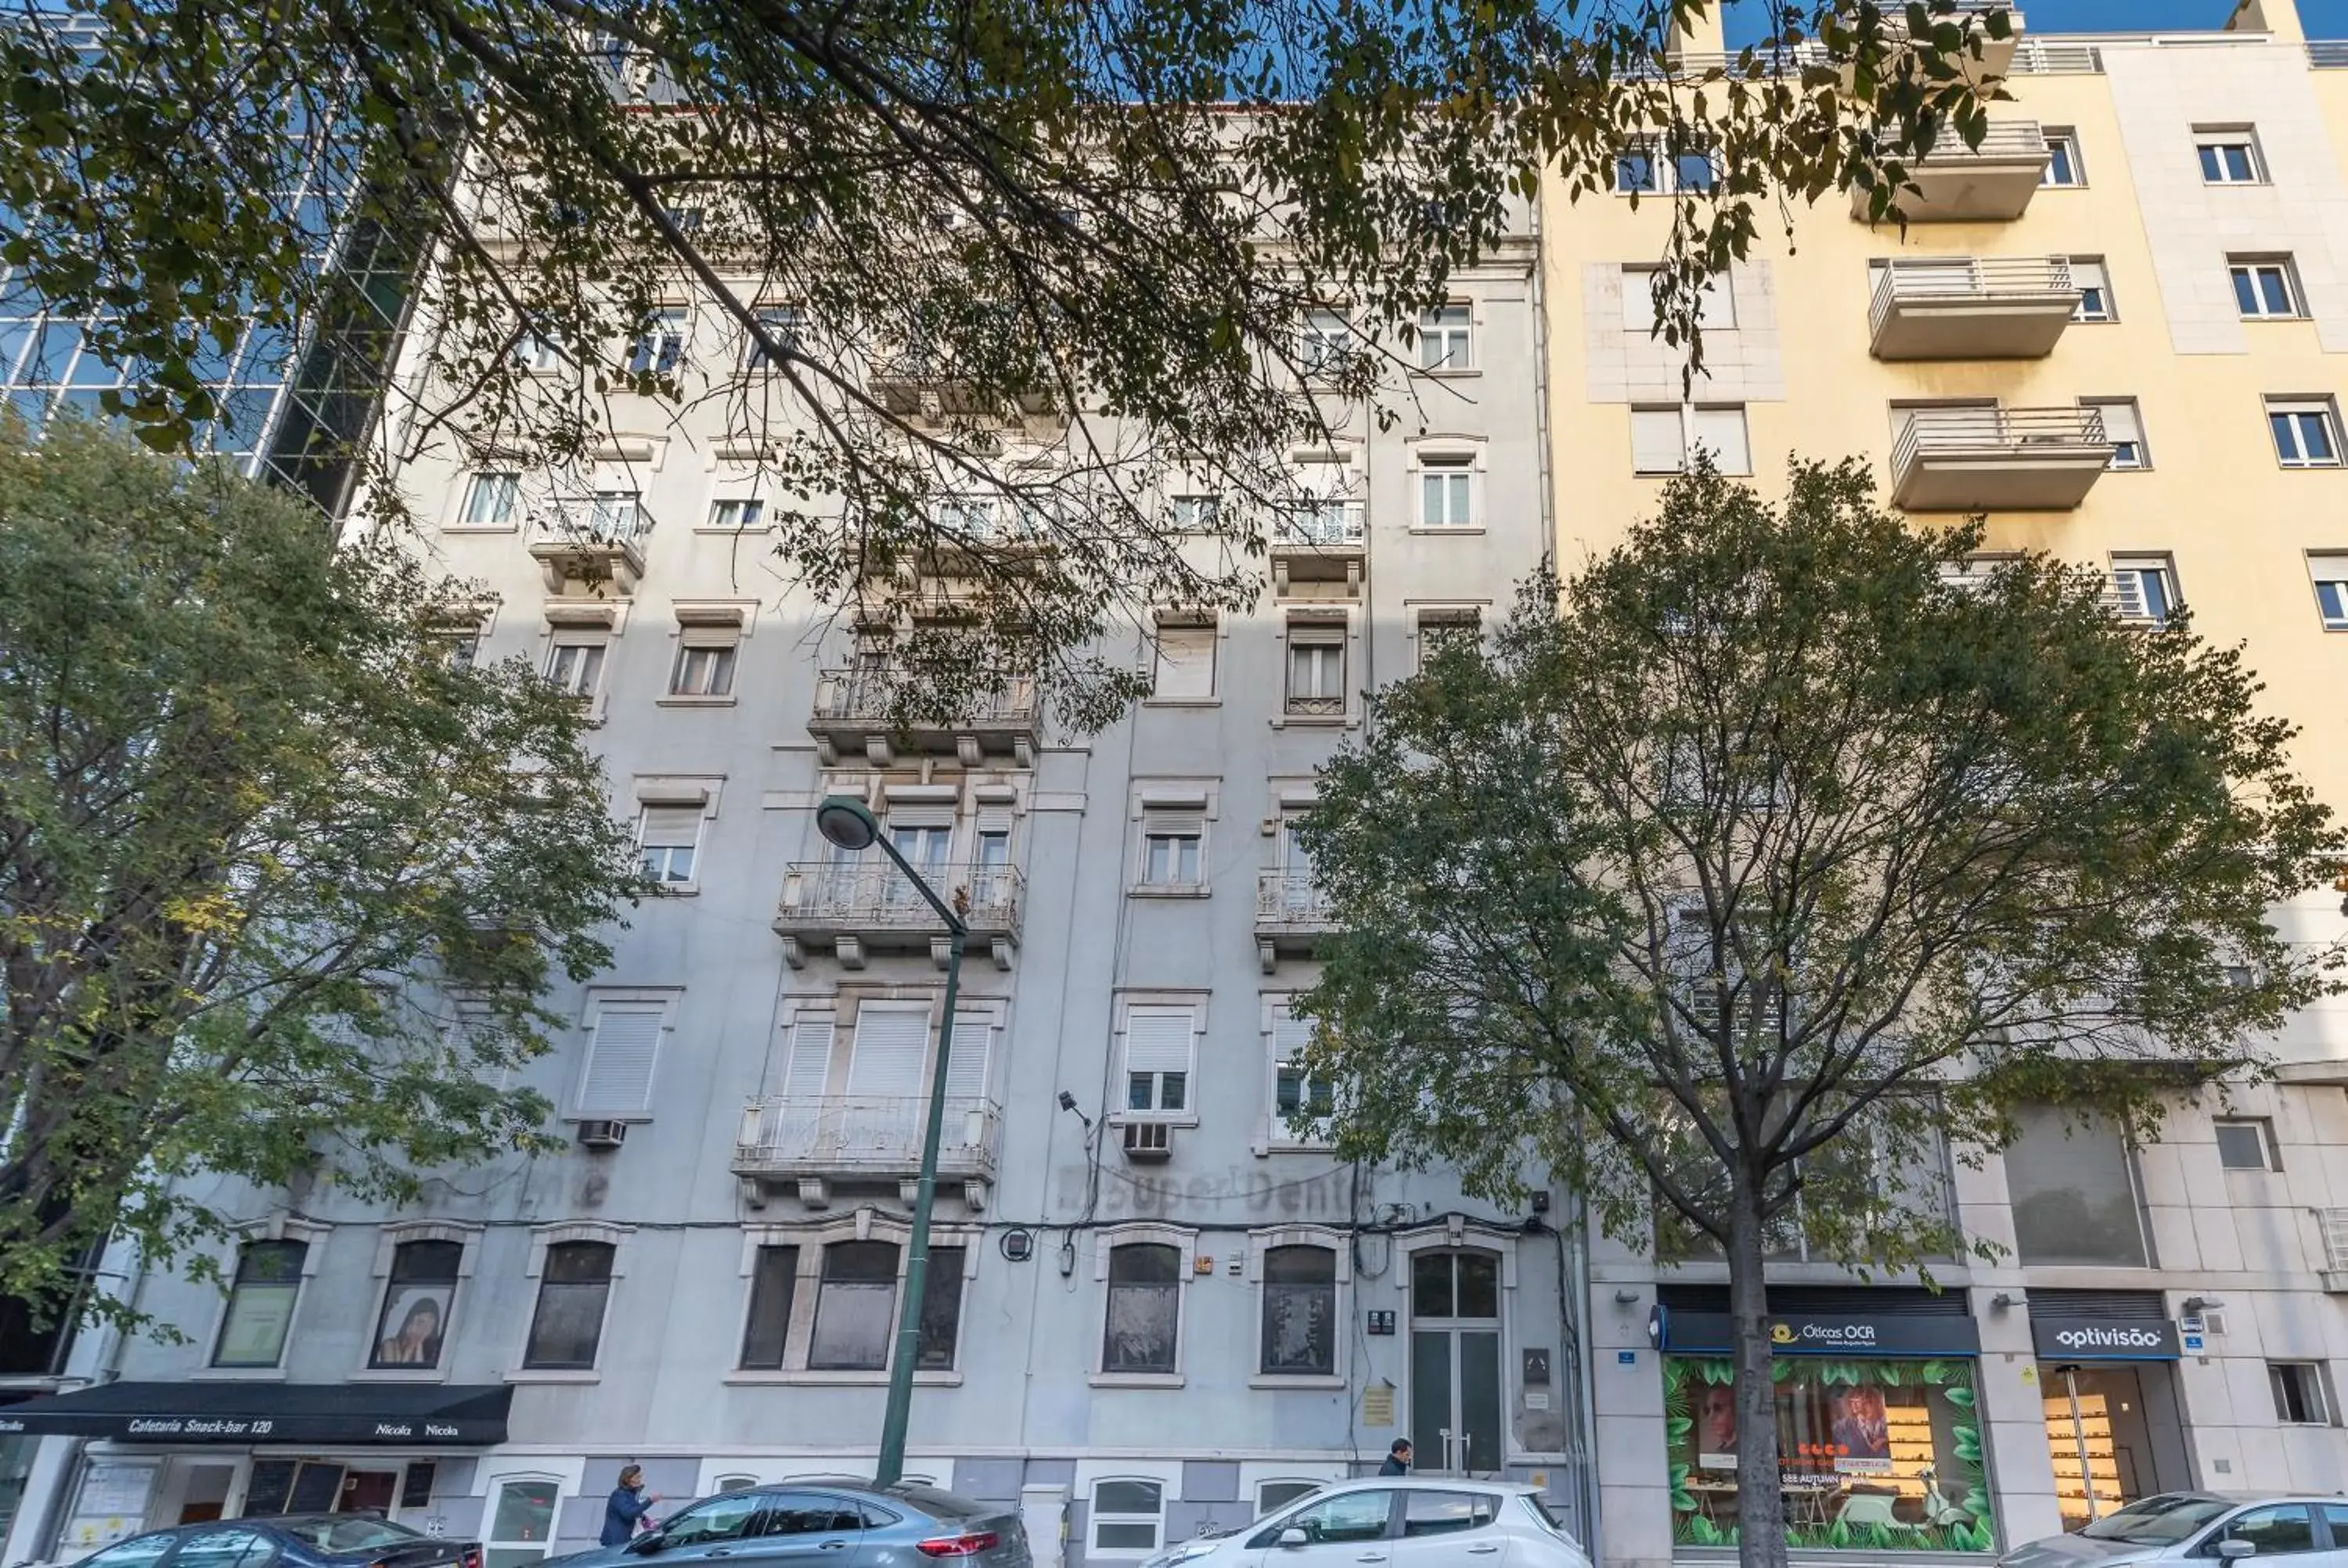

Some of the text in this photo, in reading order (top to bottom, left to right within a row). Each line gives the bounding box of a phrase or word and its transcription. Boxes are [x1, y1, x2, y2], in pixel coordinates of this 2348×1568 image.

[1845, 1325, 1875, 1339] OCR
[2057, 1328, 2160, 1348] optivisão
[185, 1419, 248, 1433] Snack-bar
[425, 1424, 459, 1436] Nicola
